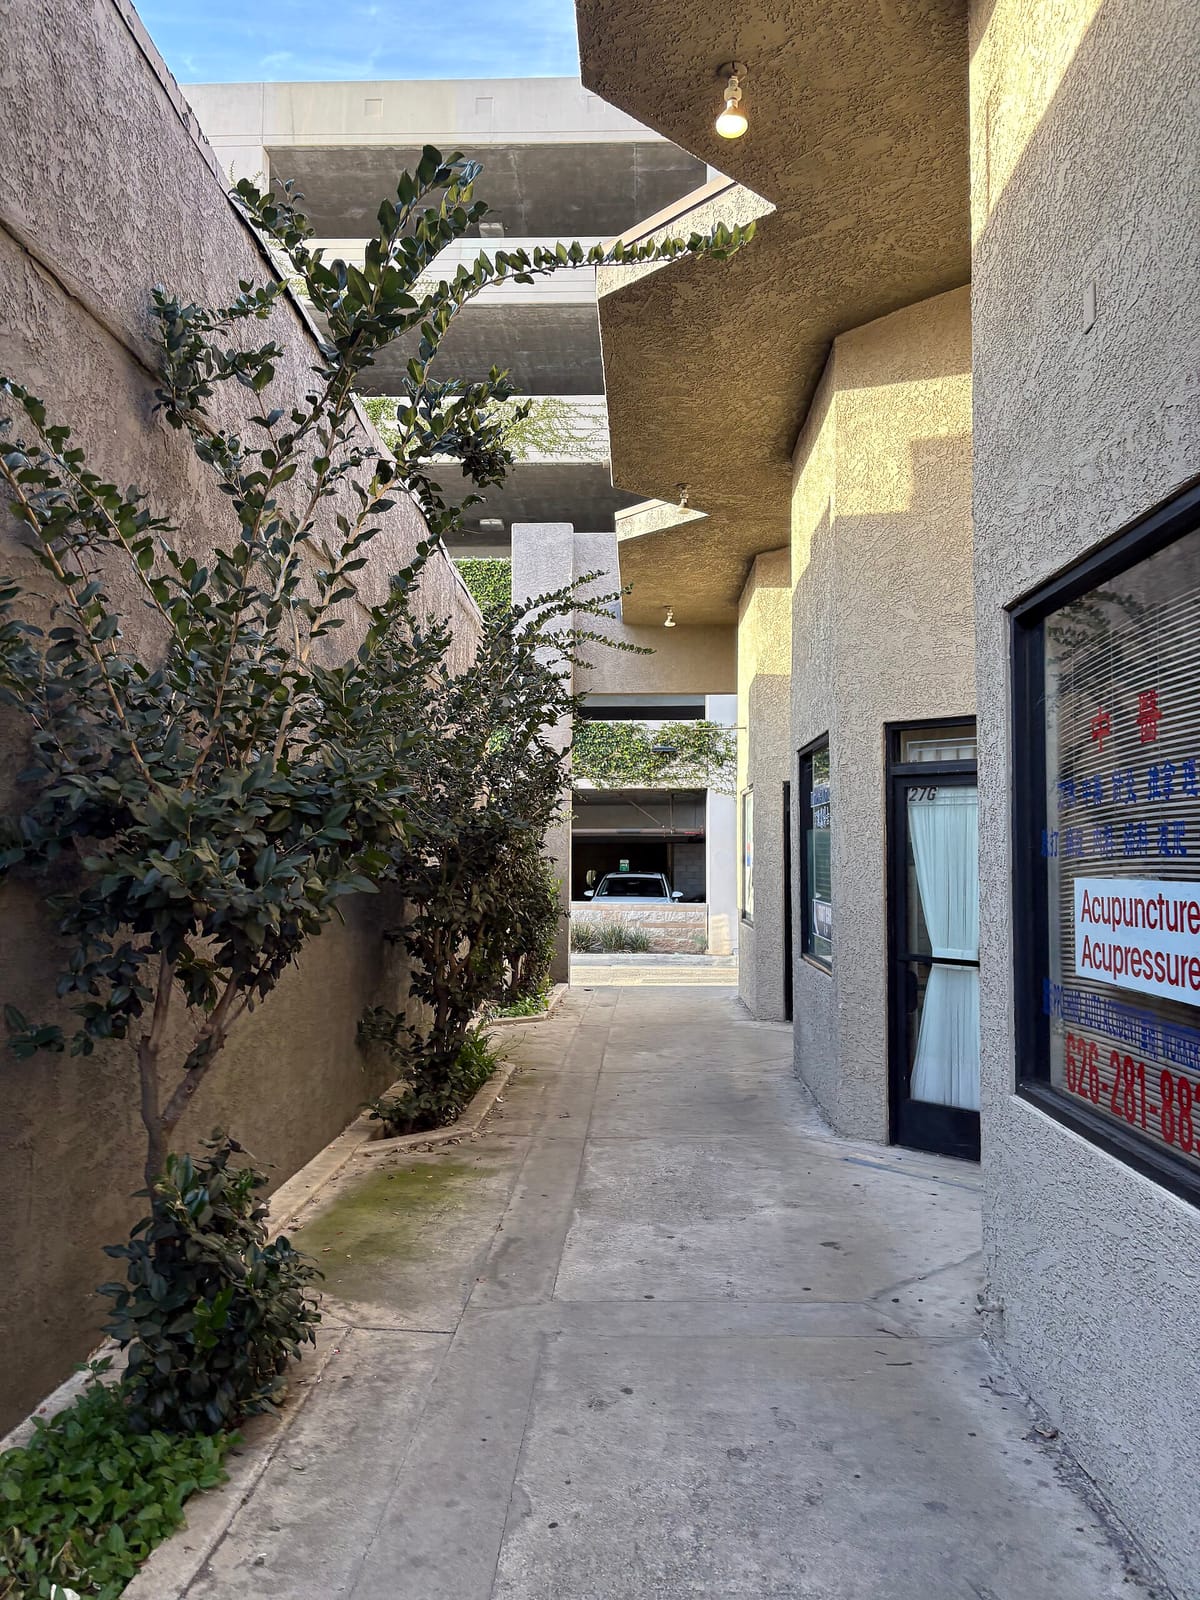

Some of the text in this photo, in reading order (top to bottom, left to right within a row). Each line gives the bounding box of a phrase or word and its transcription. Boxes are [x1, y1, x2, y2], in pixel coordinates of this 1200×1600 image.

[908, 787, 937, 801] 27G
[1081, 889, 1200, 935] Acupuncture
[1081, 935, 1200, 991] Acupressure
[1065, 1032, 1200, 1156] 626-281-88
